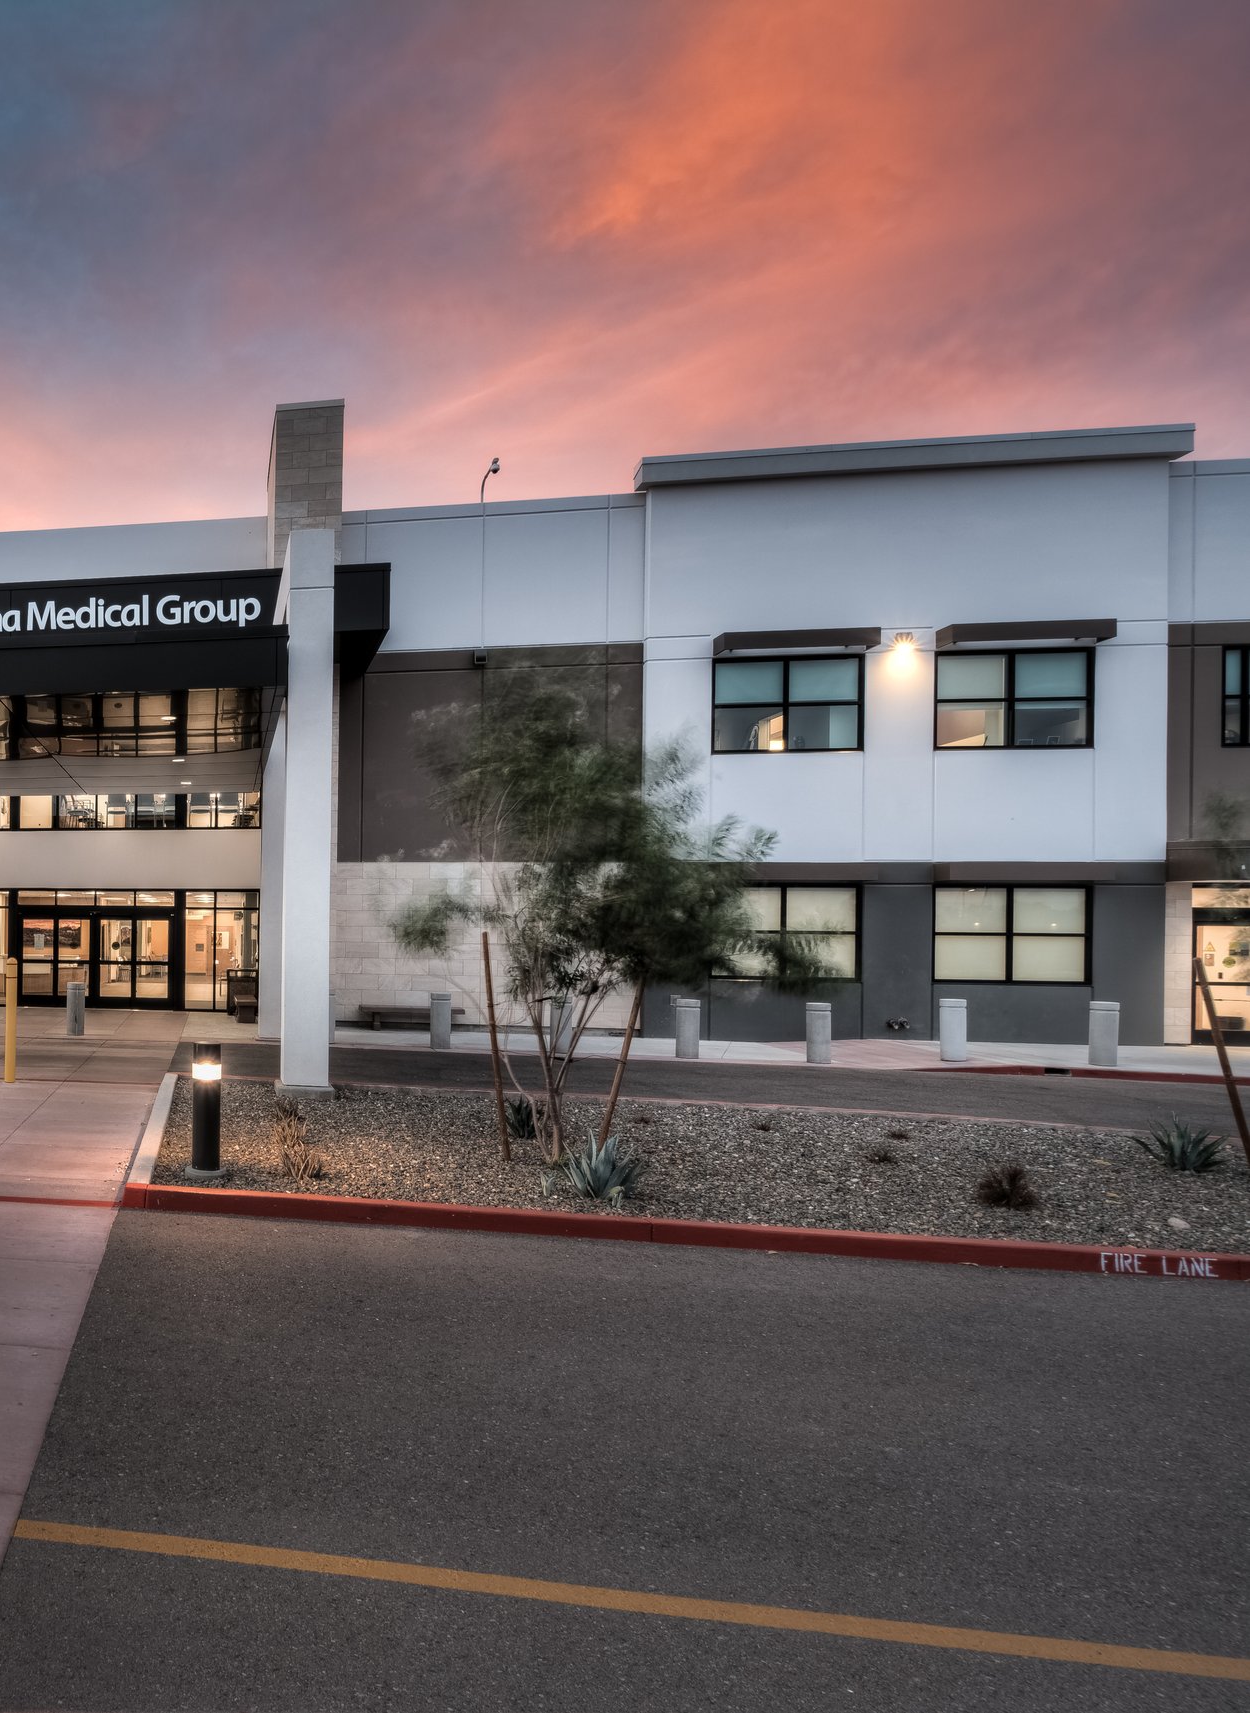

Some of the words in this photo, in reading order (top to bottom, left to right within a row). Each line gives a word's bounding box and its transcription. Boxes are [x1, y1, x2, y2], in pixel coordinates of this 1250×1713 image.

[26, 594, 149, 631] Medical
[156, 594, 261, 627] Group
[1100, 1252, 1148, 1274] FIRE
[1162, 1255, 1219, 1278] LANE
